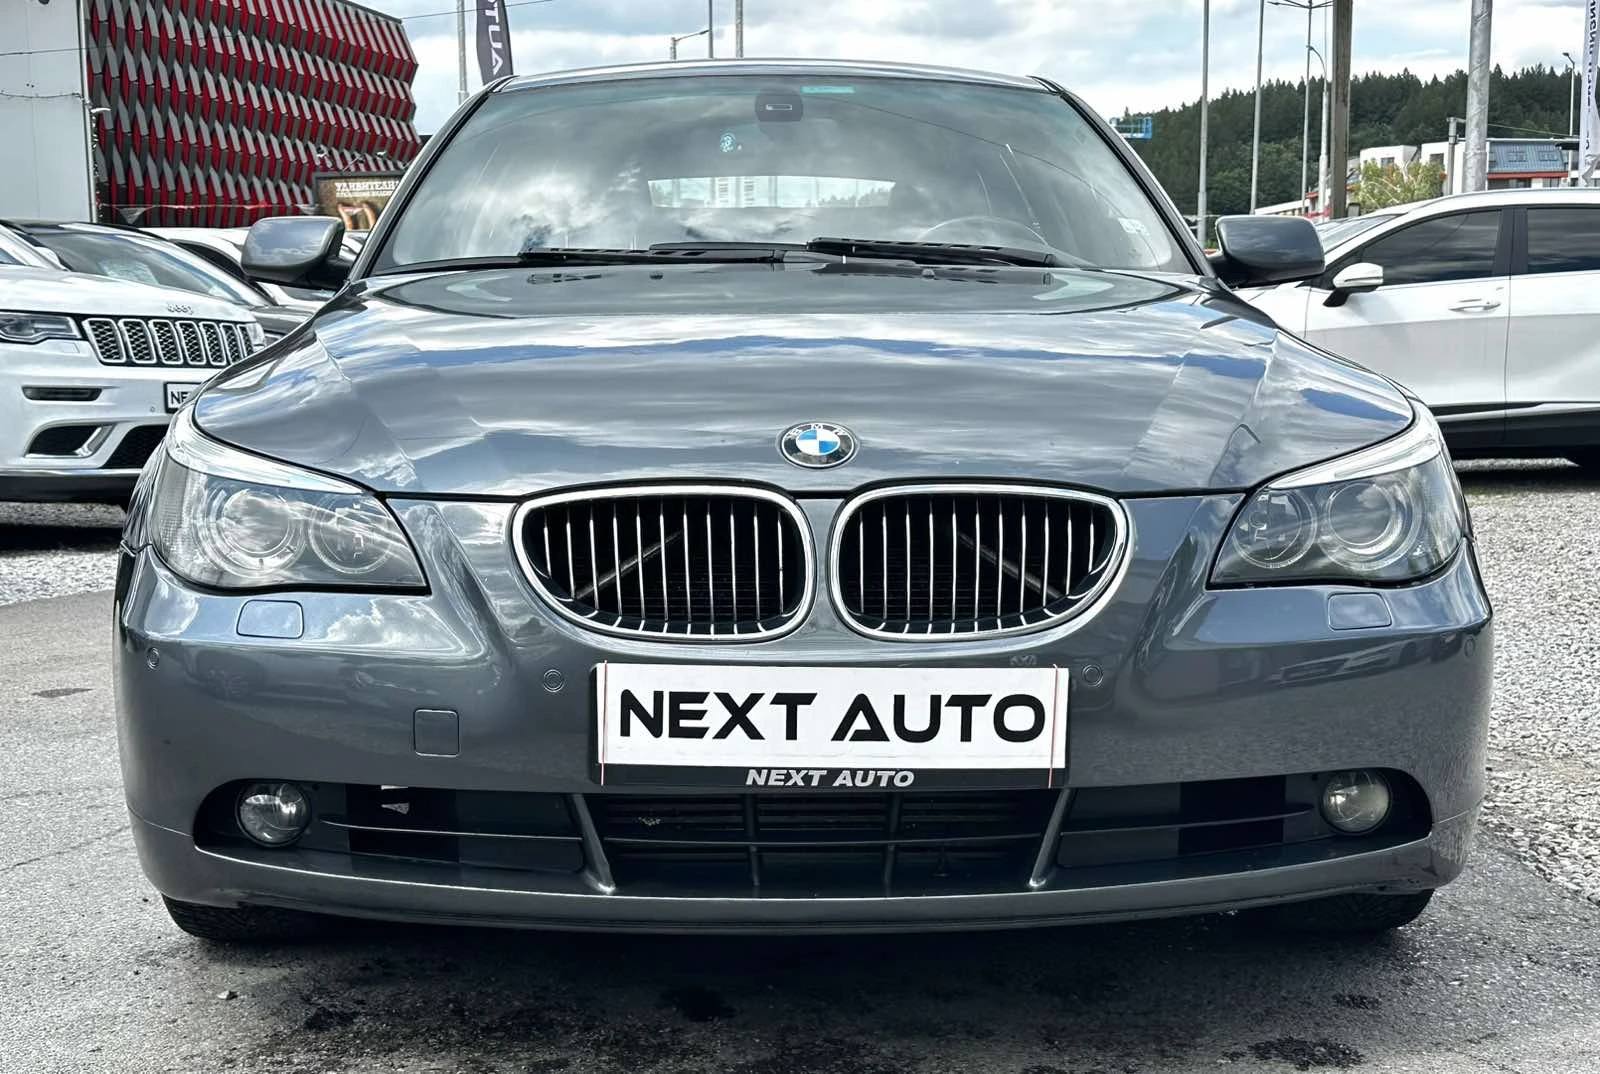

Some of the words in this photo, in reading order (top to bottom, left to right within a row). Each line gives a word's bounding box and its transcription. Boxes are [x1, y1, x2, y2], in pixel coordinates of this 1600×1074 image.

[620, 689, 818, 740] NEXT
[830, 693, 1046, 743] AUTO
[745, 769, 828, 786] NEXT
[832, 770, 915, 787] AUTO
